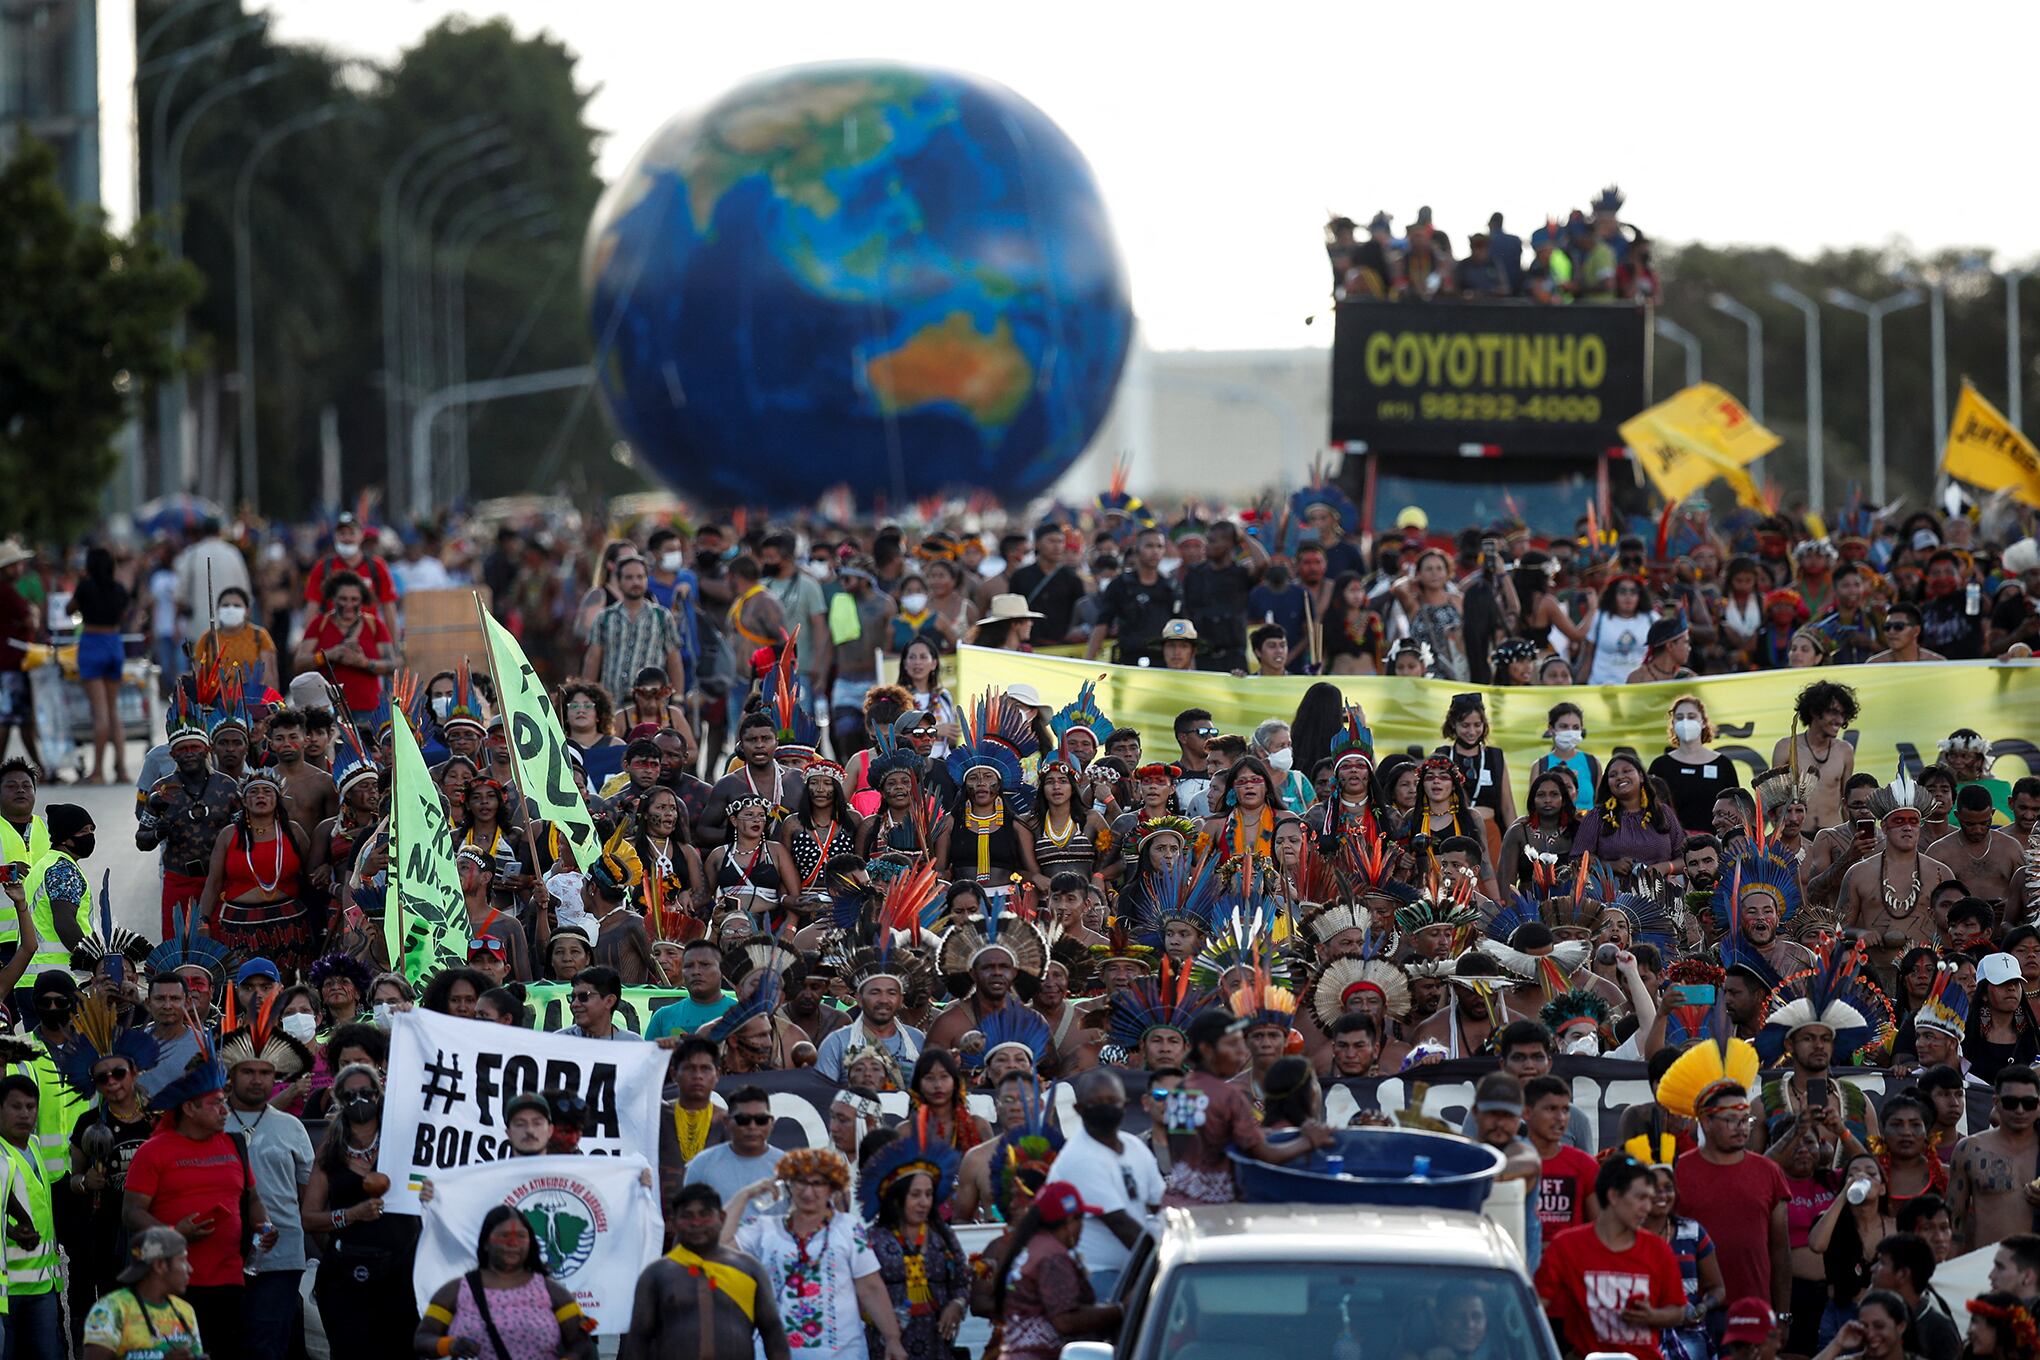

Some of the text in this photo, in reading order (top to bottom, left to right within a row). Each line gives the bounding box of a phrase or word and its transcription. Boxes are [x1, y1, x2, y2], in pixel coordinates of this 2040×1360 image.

[1365, 331, 1606, 388] COYOTINHO
[529, 1177, 569, 1190] ATINGIDOS
[1542, 1178, 1564, 1194] ET
[1538, 1195, 1570, 1211] UD
